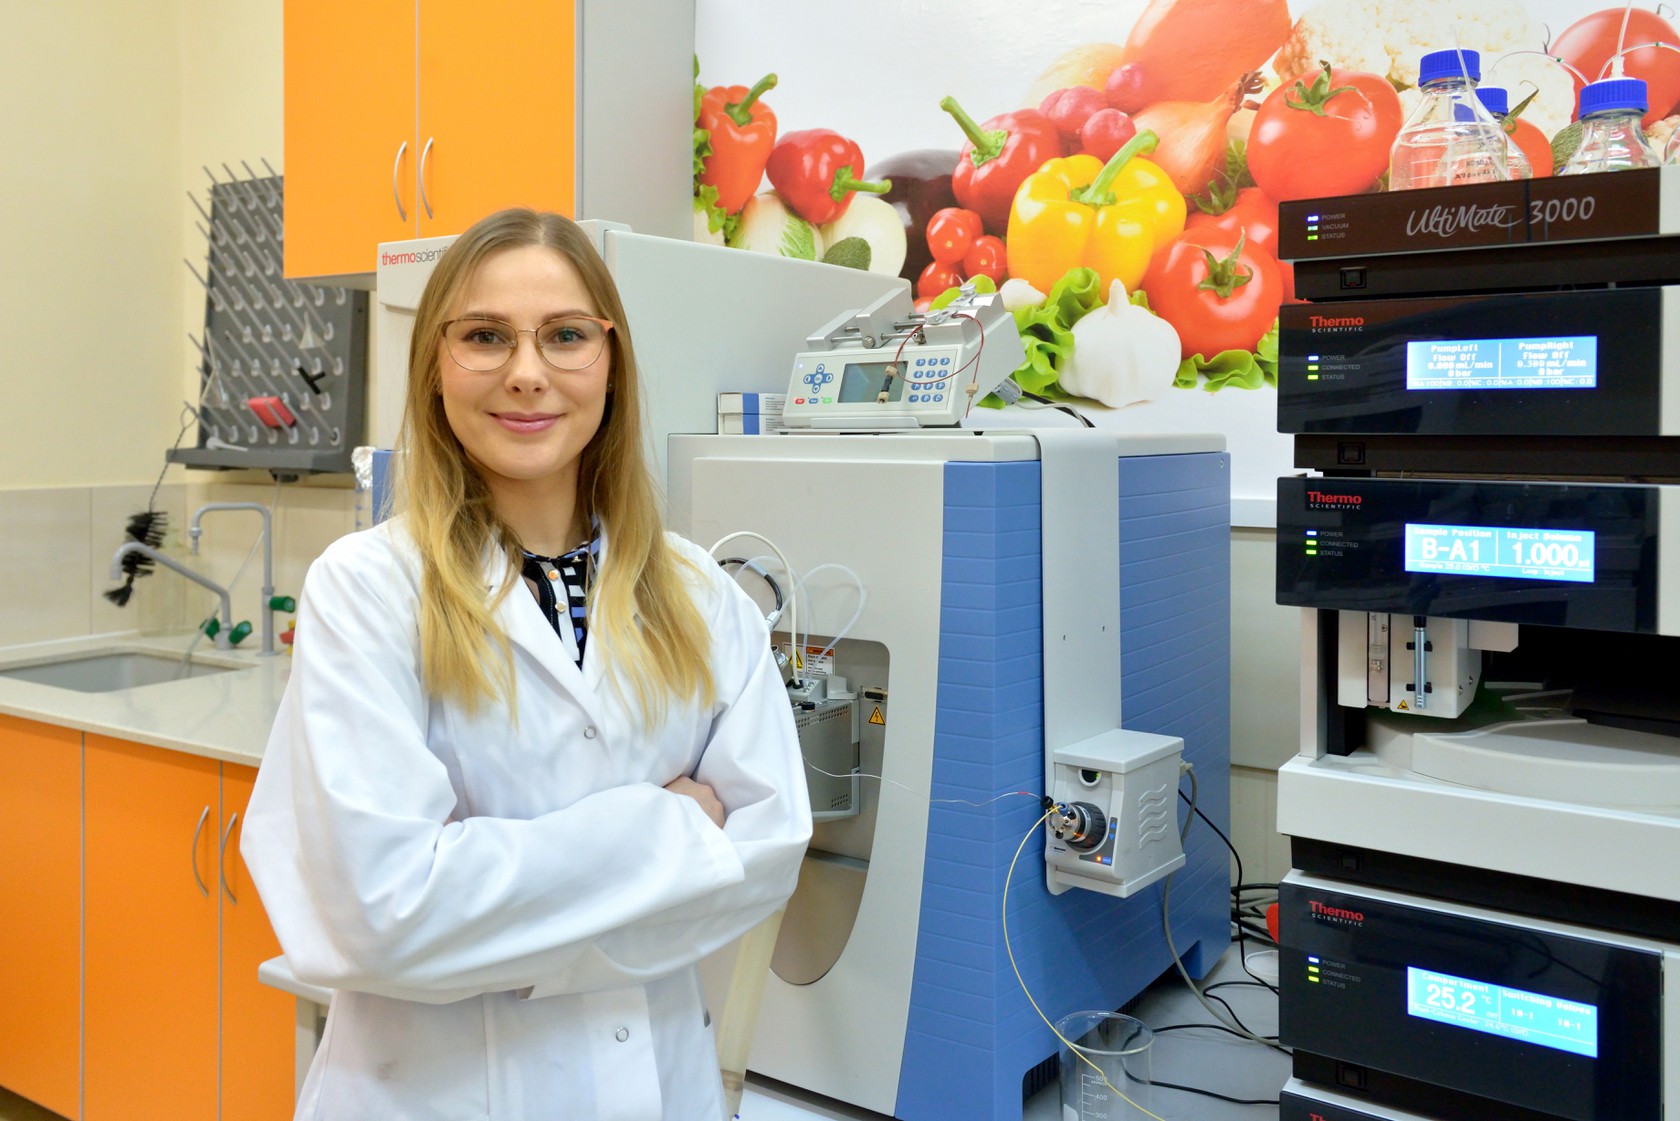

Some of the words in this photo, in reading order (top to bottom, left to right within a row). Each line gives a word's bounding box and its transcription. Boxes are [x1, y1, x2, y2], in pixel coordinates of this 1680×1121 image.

[1406, 204, 1523, 237] UltiMate
[1529, 196, 1595, 224] 3000
[1321, 222, 1349, 230] VACUUM
[1309, 315, 1365, 327] Thermo
[1431, 344, 1478, 353] PumpLeft
[1518, 341, 1574, 350] PumpRight
[1433, 354, 1456, 362] Flow
[1523, 352, 1548, 360] Flow
[1307, 491, 1362, 504] Thermo
[1421, 537, 1480, 562] B-A1
[1512, 541, 1579, 567] 1.000
[1308, 900, 1364, 921] Thermo
[1311, 913, 1363, 927] SCIENTIFIC
[1322, 960, 1346, 969] POWER
[1322, 969, 1361, 982] CONNECTED
[1322, 979, 1346, 989] STATUS
[1426, 983, 1476, 1015] 25.2
[1502, 989, 1552, 1008] Switching
